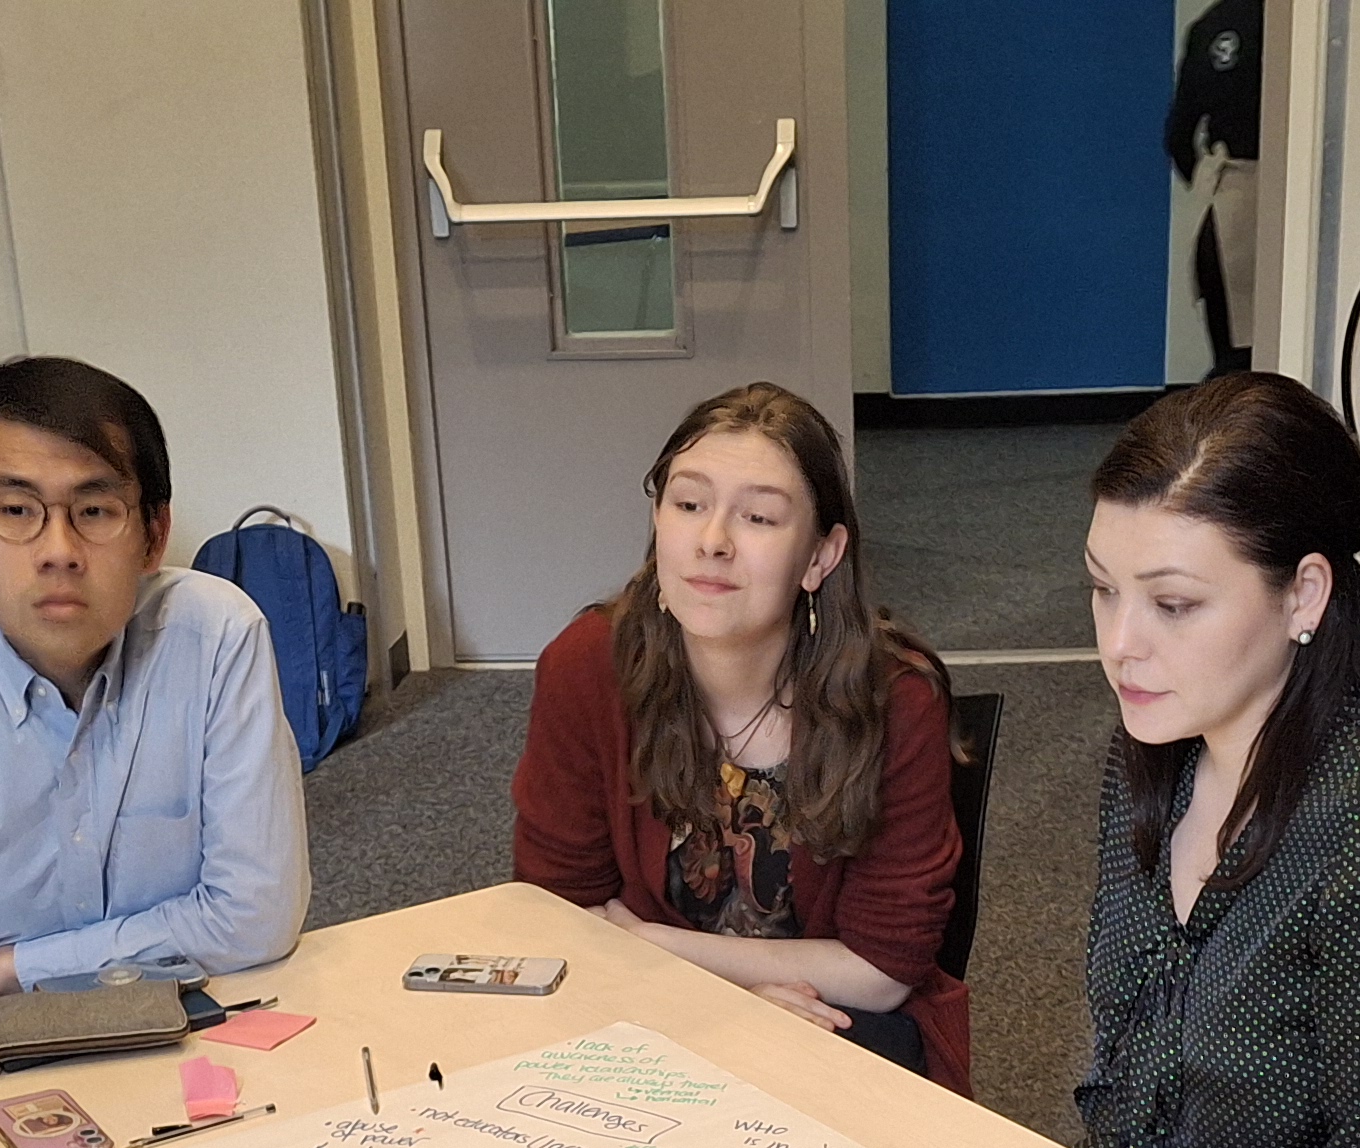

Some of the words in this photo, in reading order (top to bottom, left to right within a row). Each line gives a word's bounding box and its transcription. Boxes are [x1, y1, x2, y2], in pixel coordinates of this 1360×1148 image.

[519, 1090, 648, 1134] Challenges
[336, 1118, 399, 1134] abuse
[734, 1119, 789, 1136] WHO
